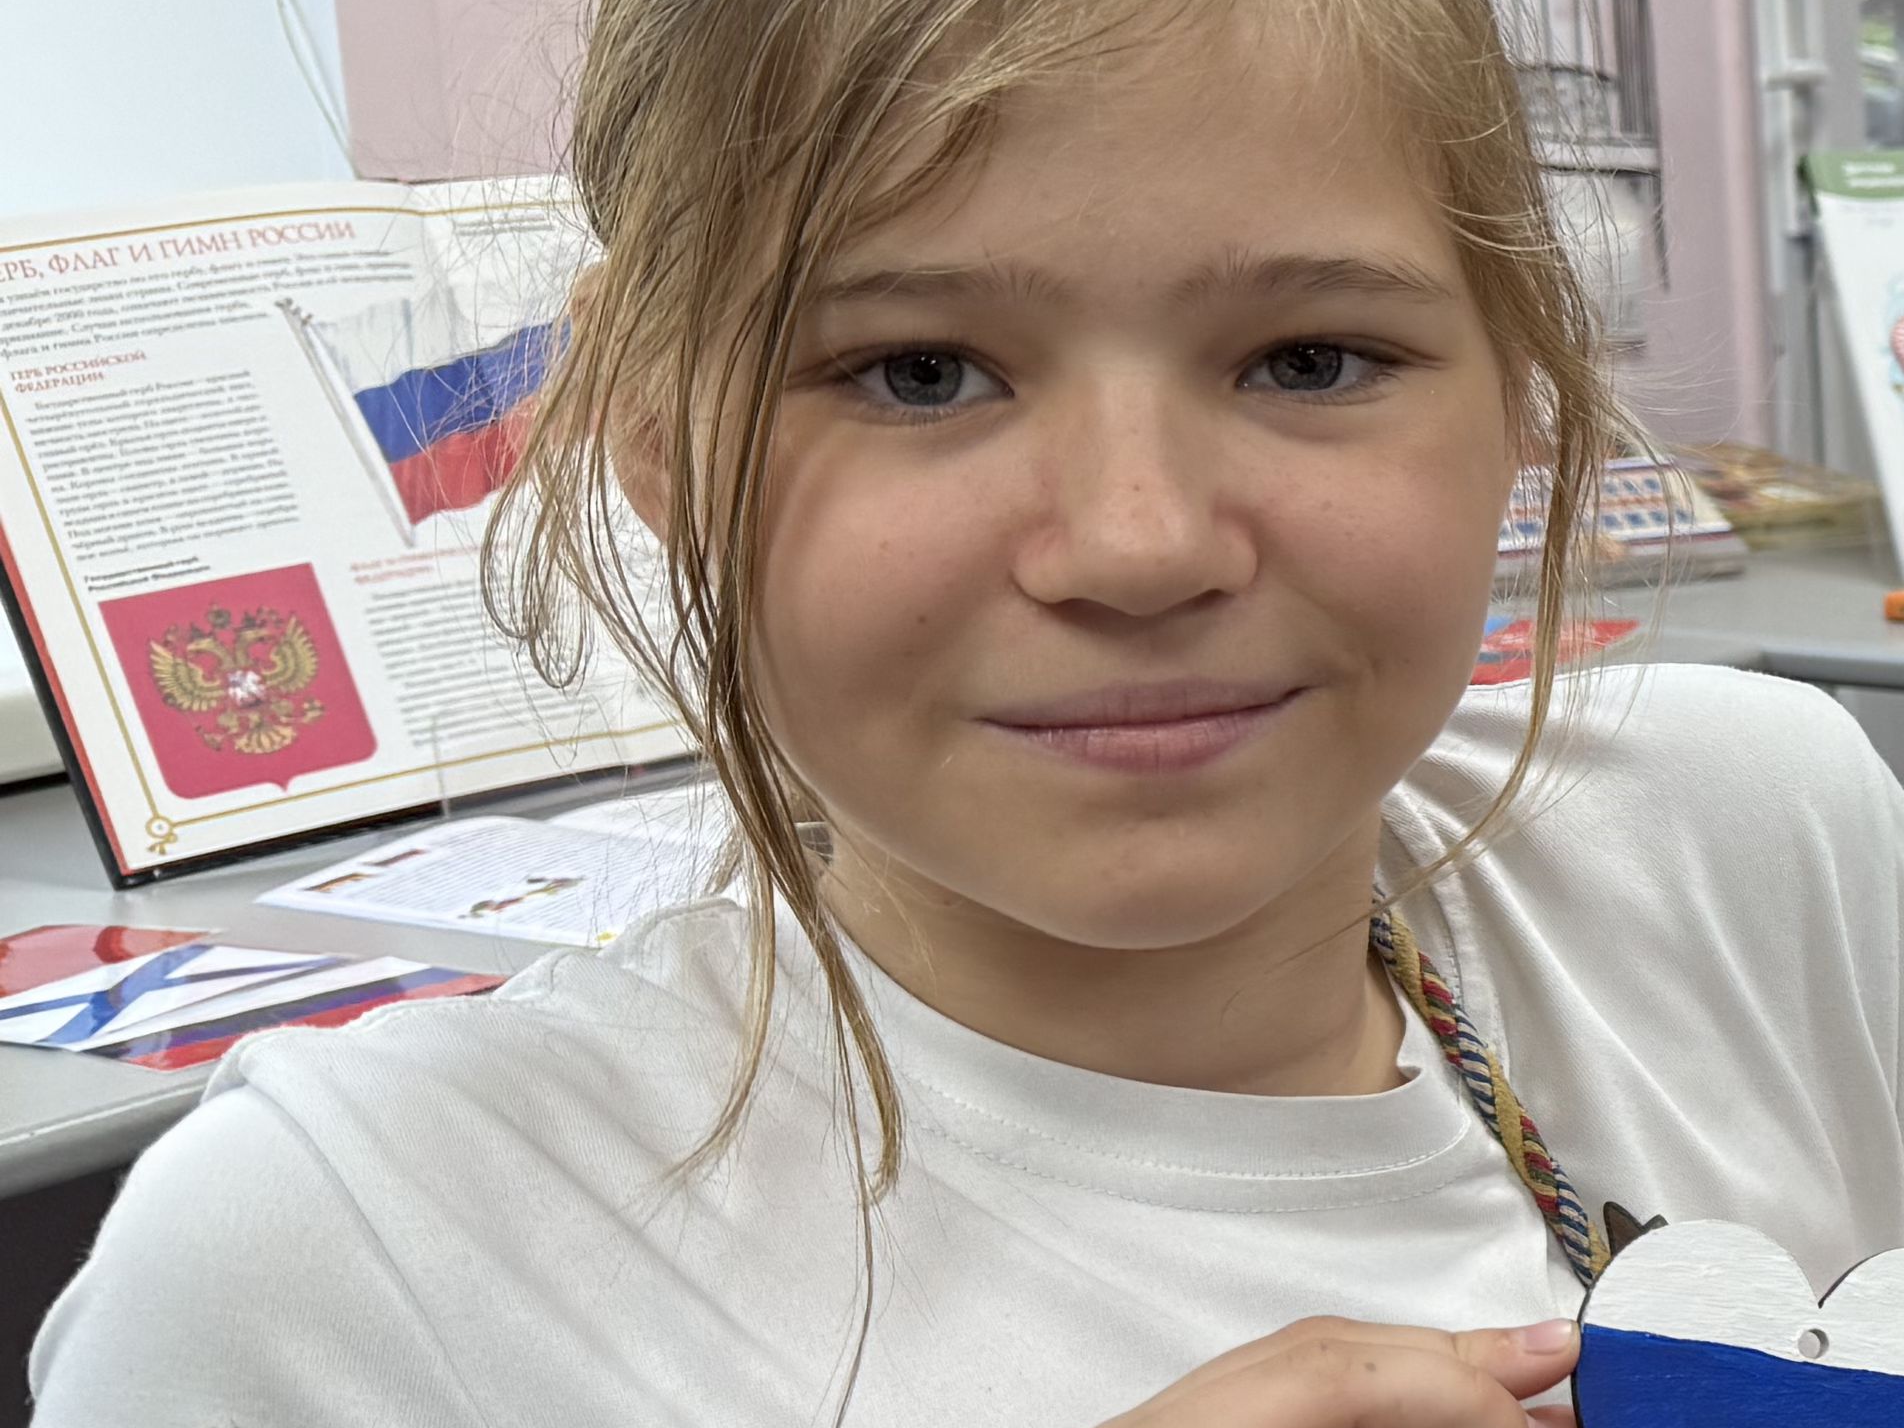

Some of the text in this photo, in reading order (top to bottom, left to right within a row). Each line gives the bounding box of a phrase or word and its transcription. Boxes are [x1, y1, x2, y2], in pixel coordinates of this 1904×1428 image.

[48, 247, 119, 274] ФЛАГ
[128, 242, 152, 263] И
[159, 231, 242, 258] ГИМН
[250, 221, 356, 249] РОССИИ
